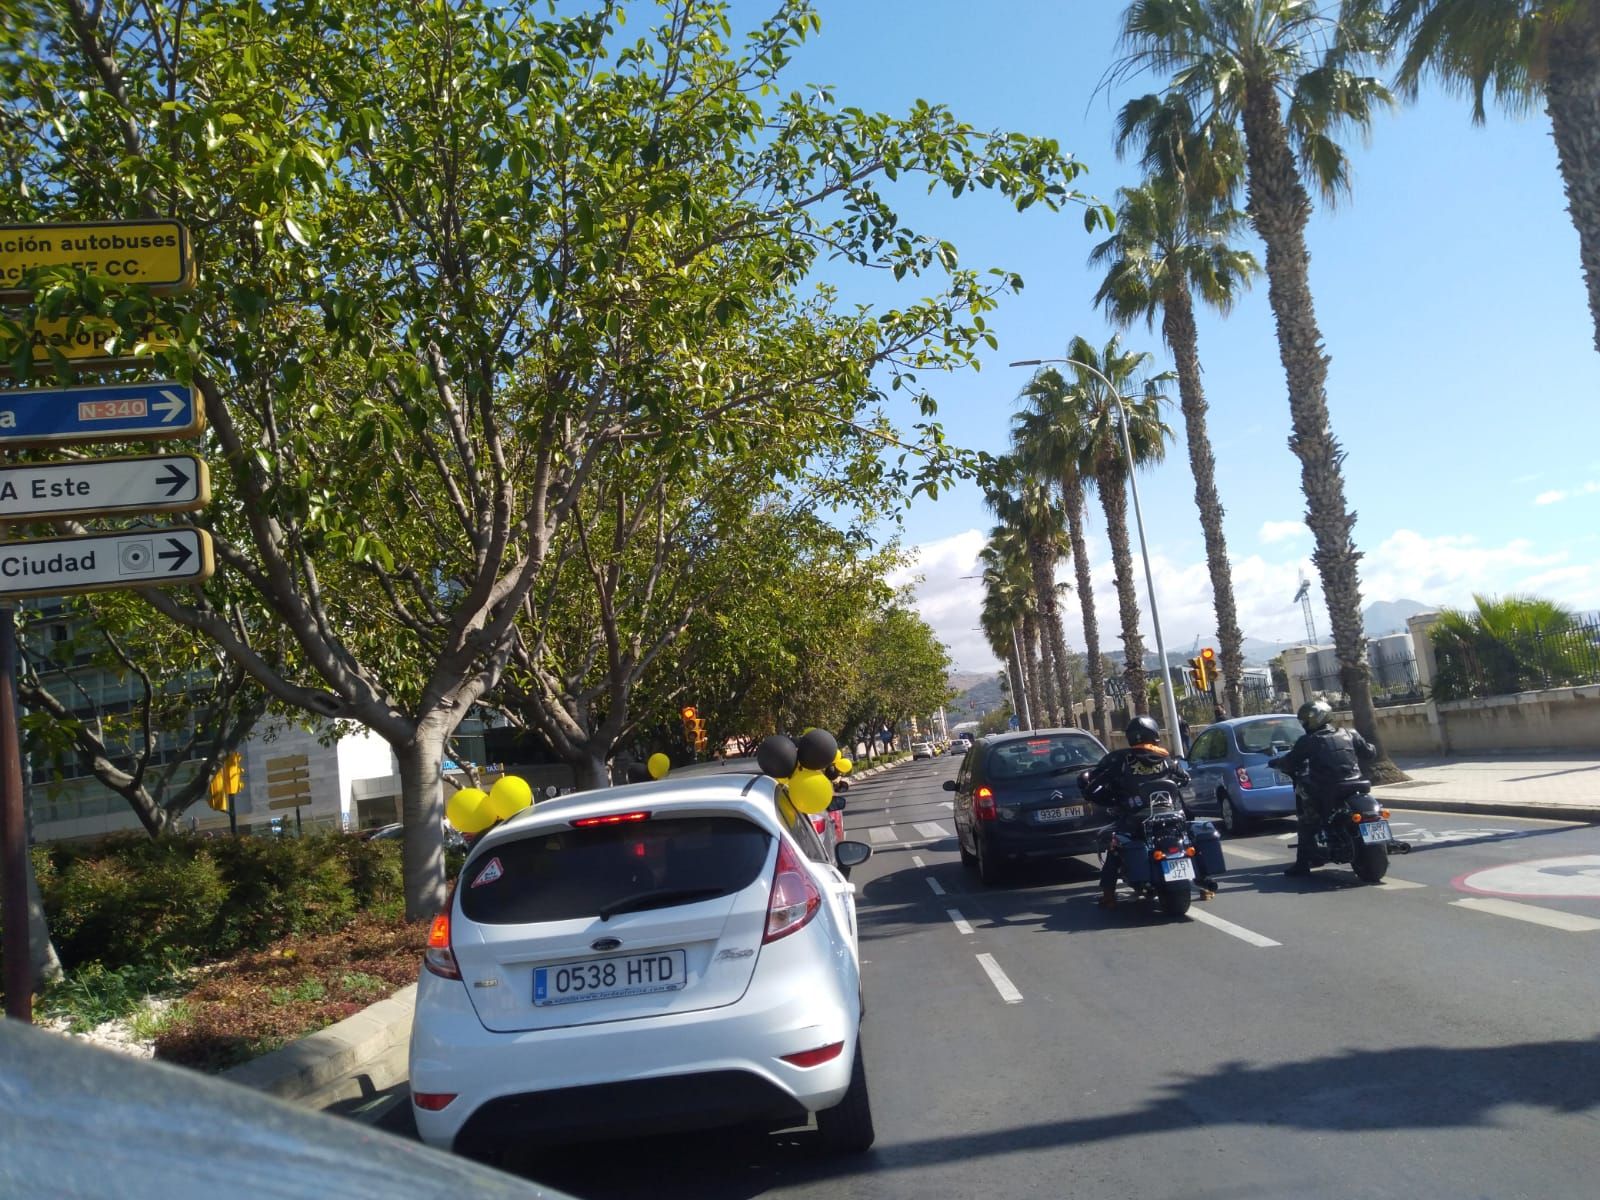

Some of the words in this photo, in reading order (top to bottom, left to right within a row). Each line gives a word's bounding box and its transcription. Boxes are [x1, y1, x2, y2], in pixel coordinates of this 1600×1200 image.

[0, 235, 52, 253] ción
[61, 234, 177, 251] autobuses
[81, 401, 146, 418] N-340
[1, 481, 18, 500] A
[31, 478, 91, 498] Este
[1, 550, 96, 577] Ciudad
[1064, 806, 1081, 817] FVH
[556, 963, 617, 993] 0538
[627, 956, 673, 985] HTD
